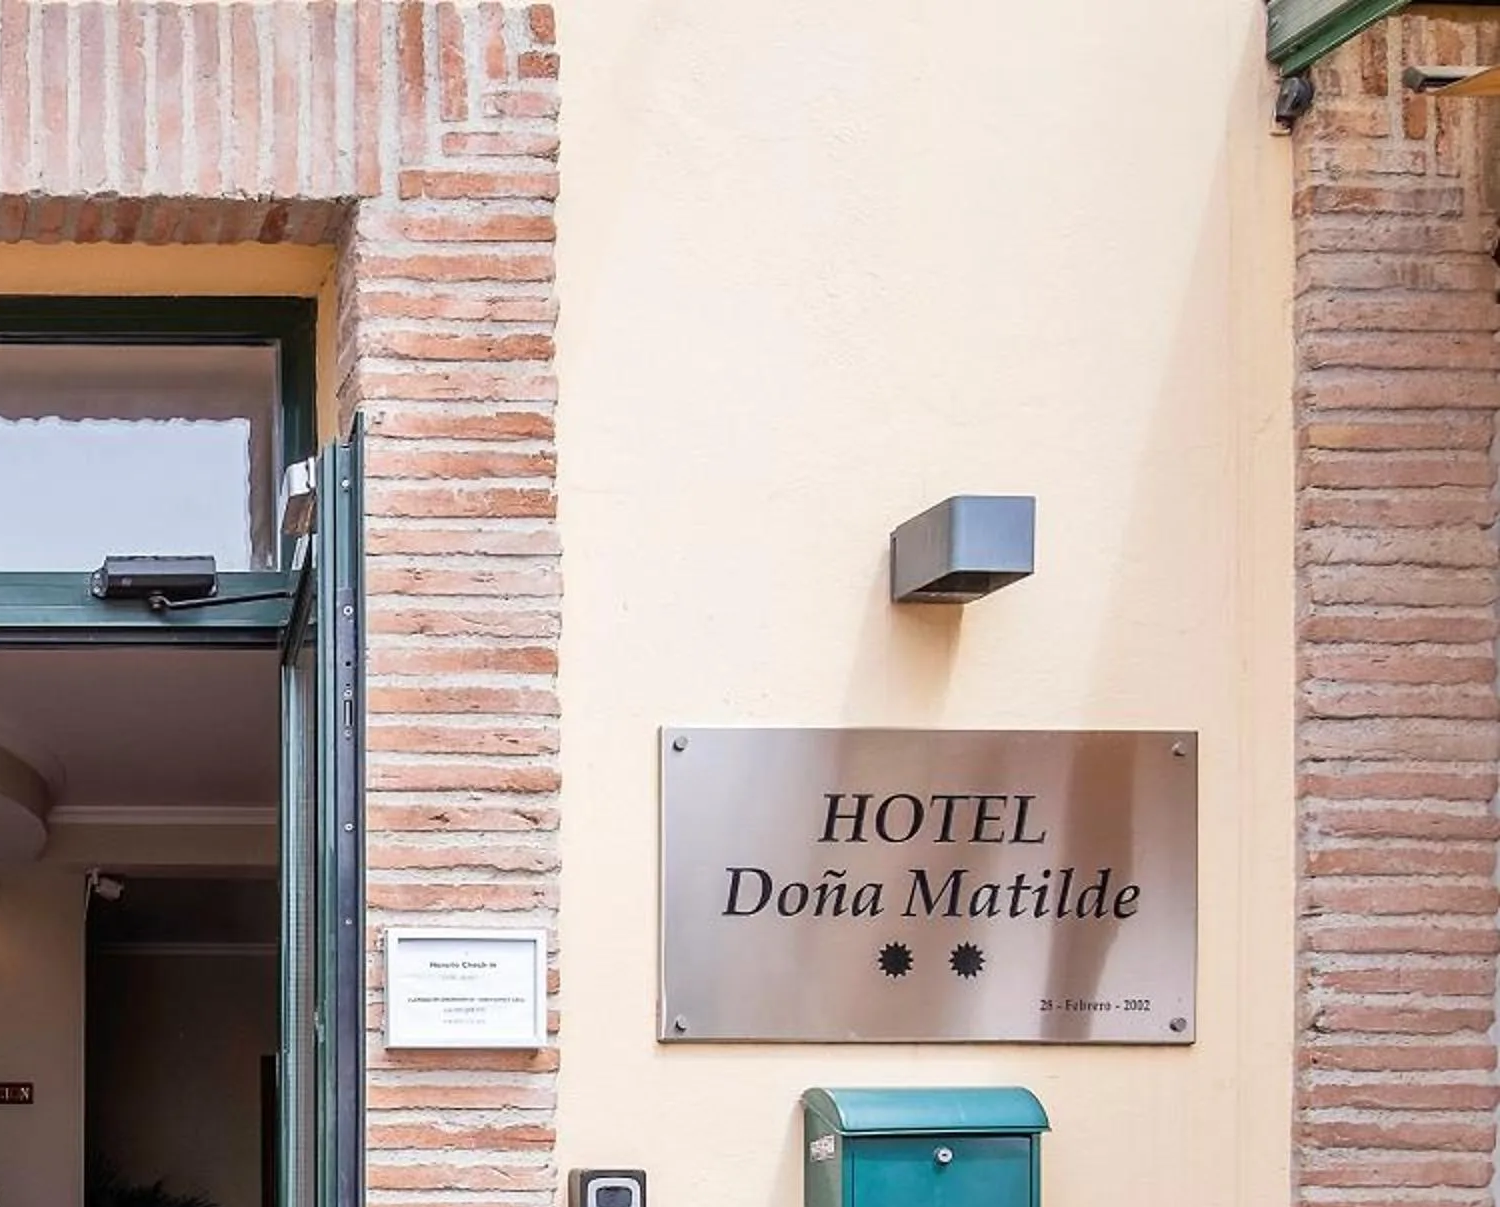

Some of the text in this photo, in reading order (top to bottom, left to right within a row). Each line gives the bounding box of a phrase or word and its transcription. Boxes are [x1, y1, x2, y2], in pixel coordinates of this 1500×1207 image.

[817, 793, 1046, 844] HOTEL
[722, 866, 1141, 920] Doña Matilde
[1065, 999, 1111, 1011] Febrero
